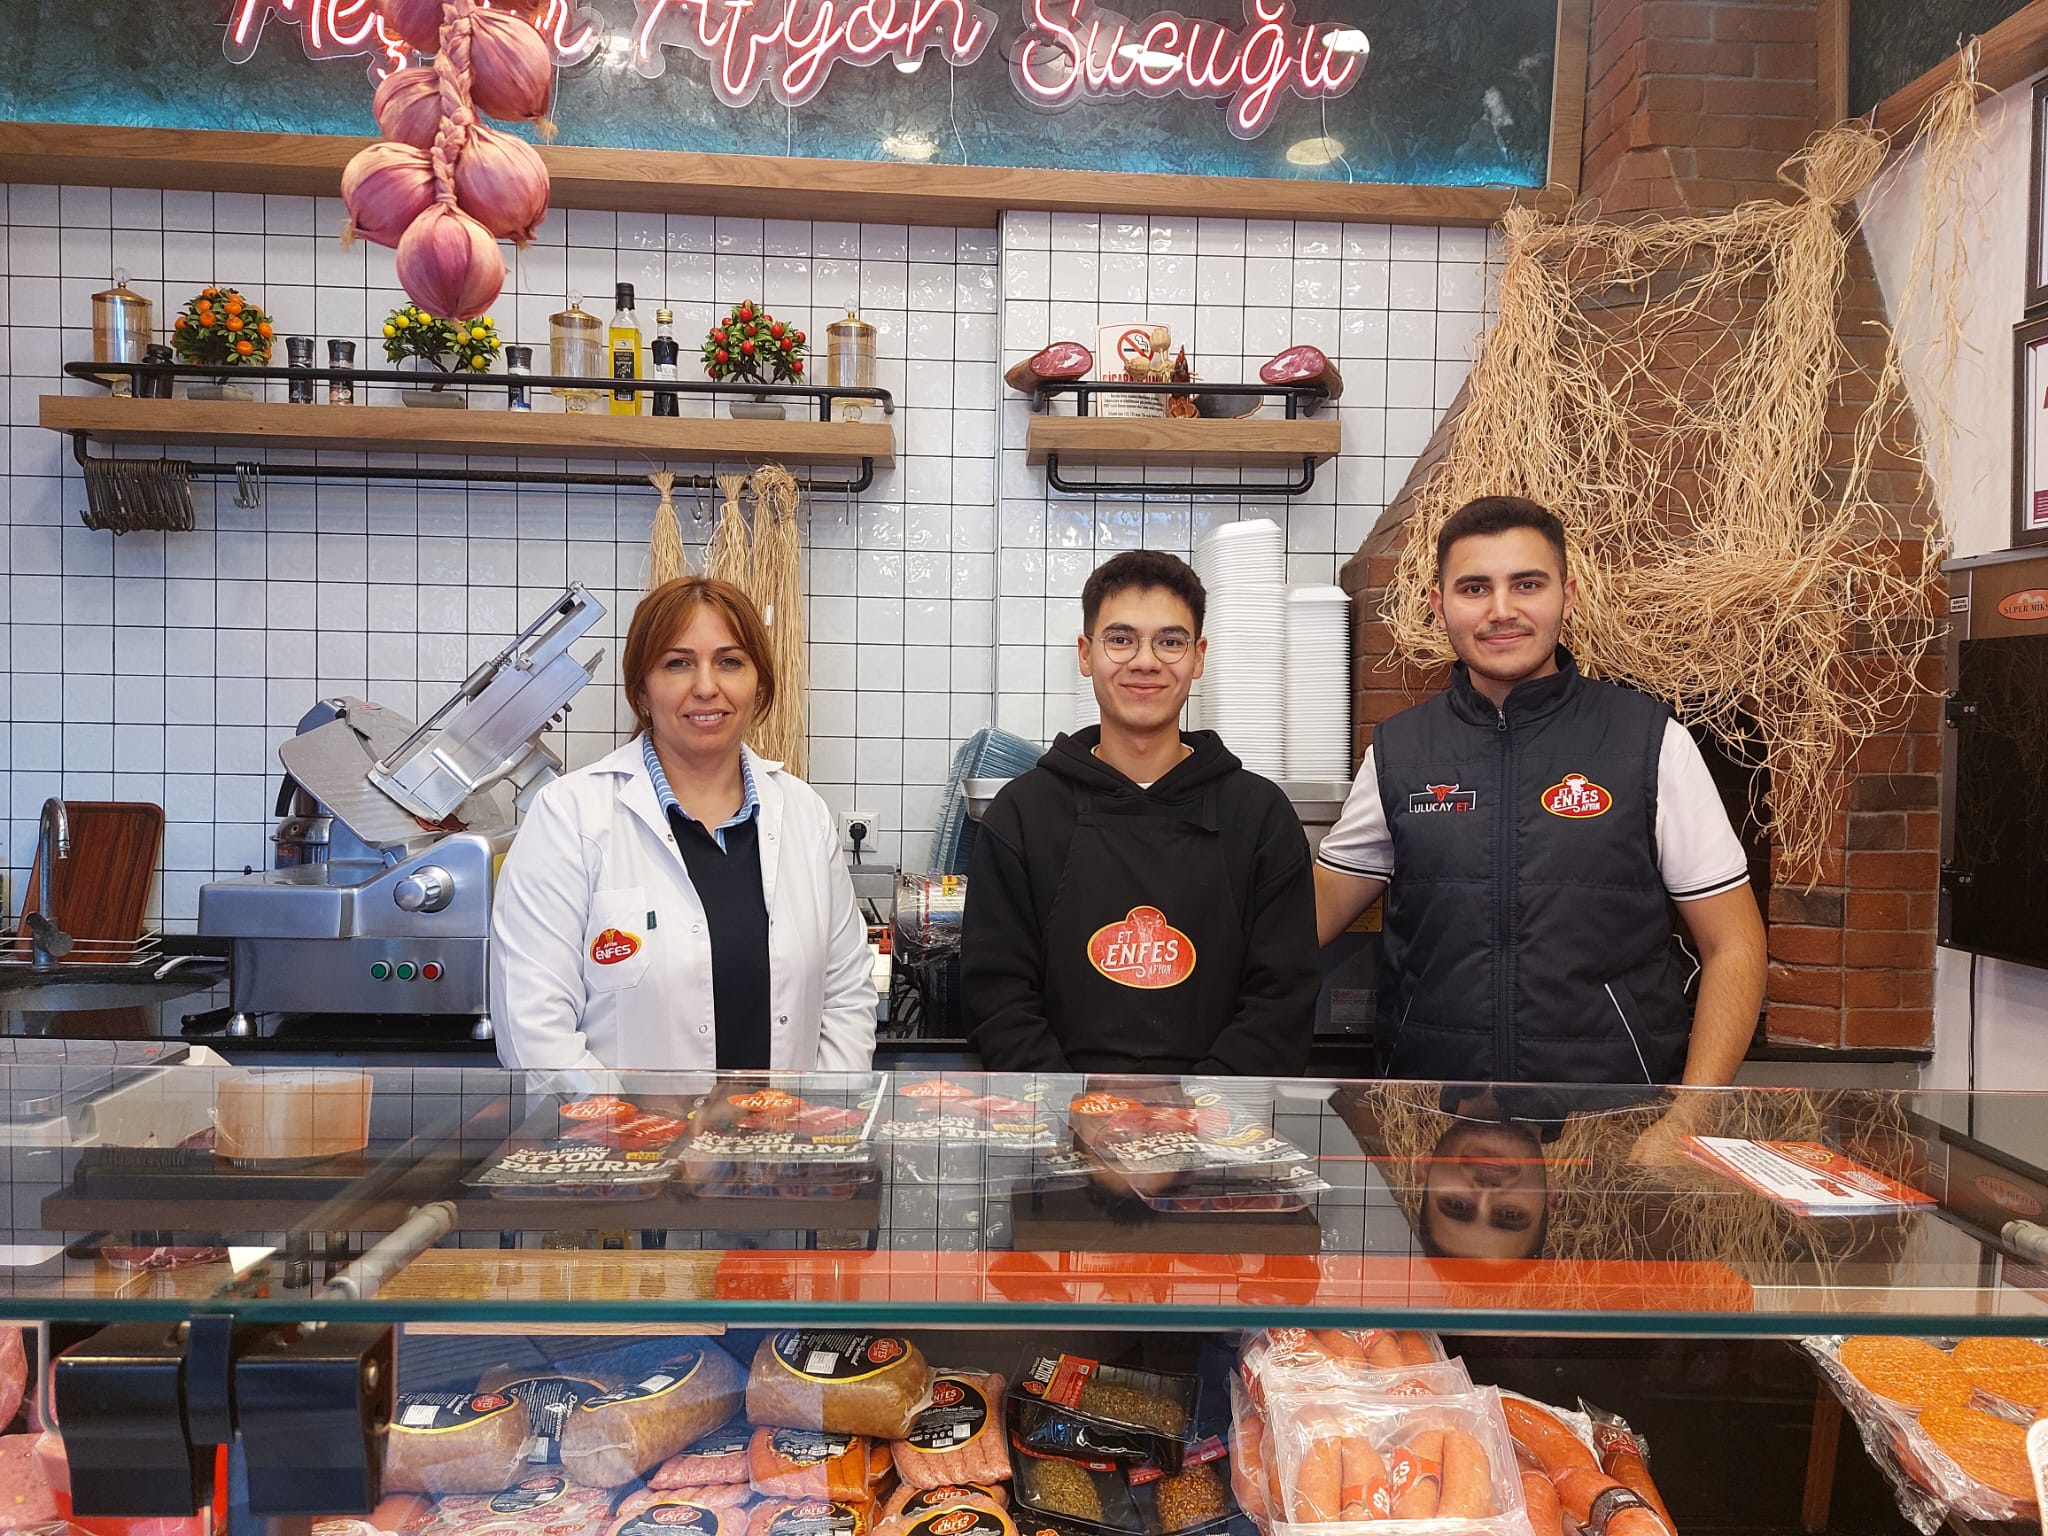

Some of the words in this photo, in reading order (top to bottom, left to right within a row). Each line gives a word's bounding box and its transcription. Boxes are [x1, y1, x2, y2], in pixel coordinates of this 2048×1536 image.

[1021, 0, 1356, 128] Sucuğu
[1455, 801, 1470, 813] ET
[1553, 789, 1599, 809] ENFES
[1117, 930, 1134, 944] ET
[595, 944, 632, 960] ENFES
[1105, 939, 1179, 966] ENFES
[506, 1151, 607, 1163] AFYON
[1033, 1357, 1058, 1383] SUCUK
[933, 1389, 957, 1402] NFES
